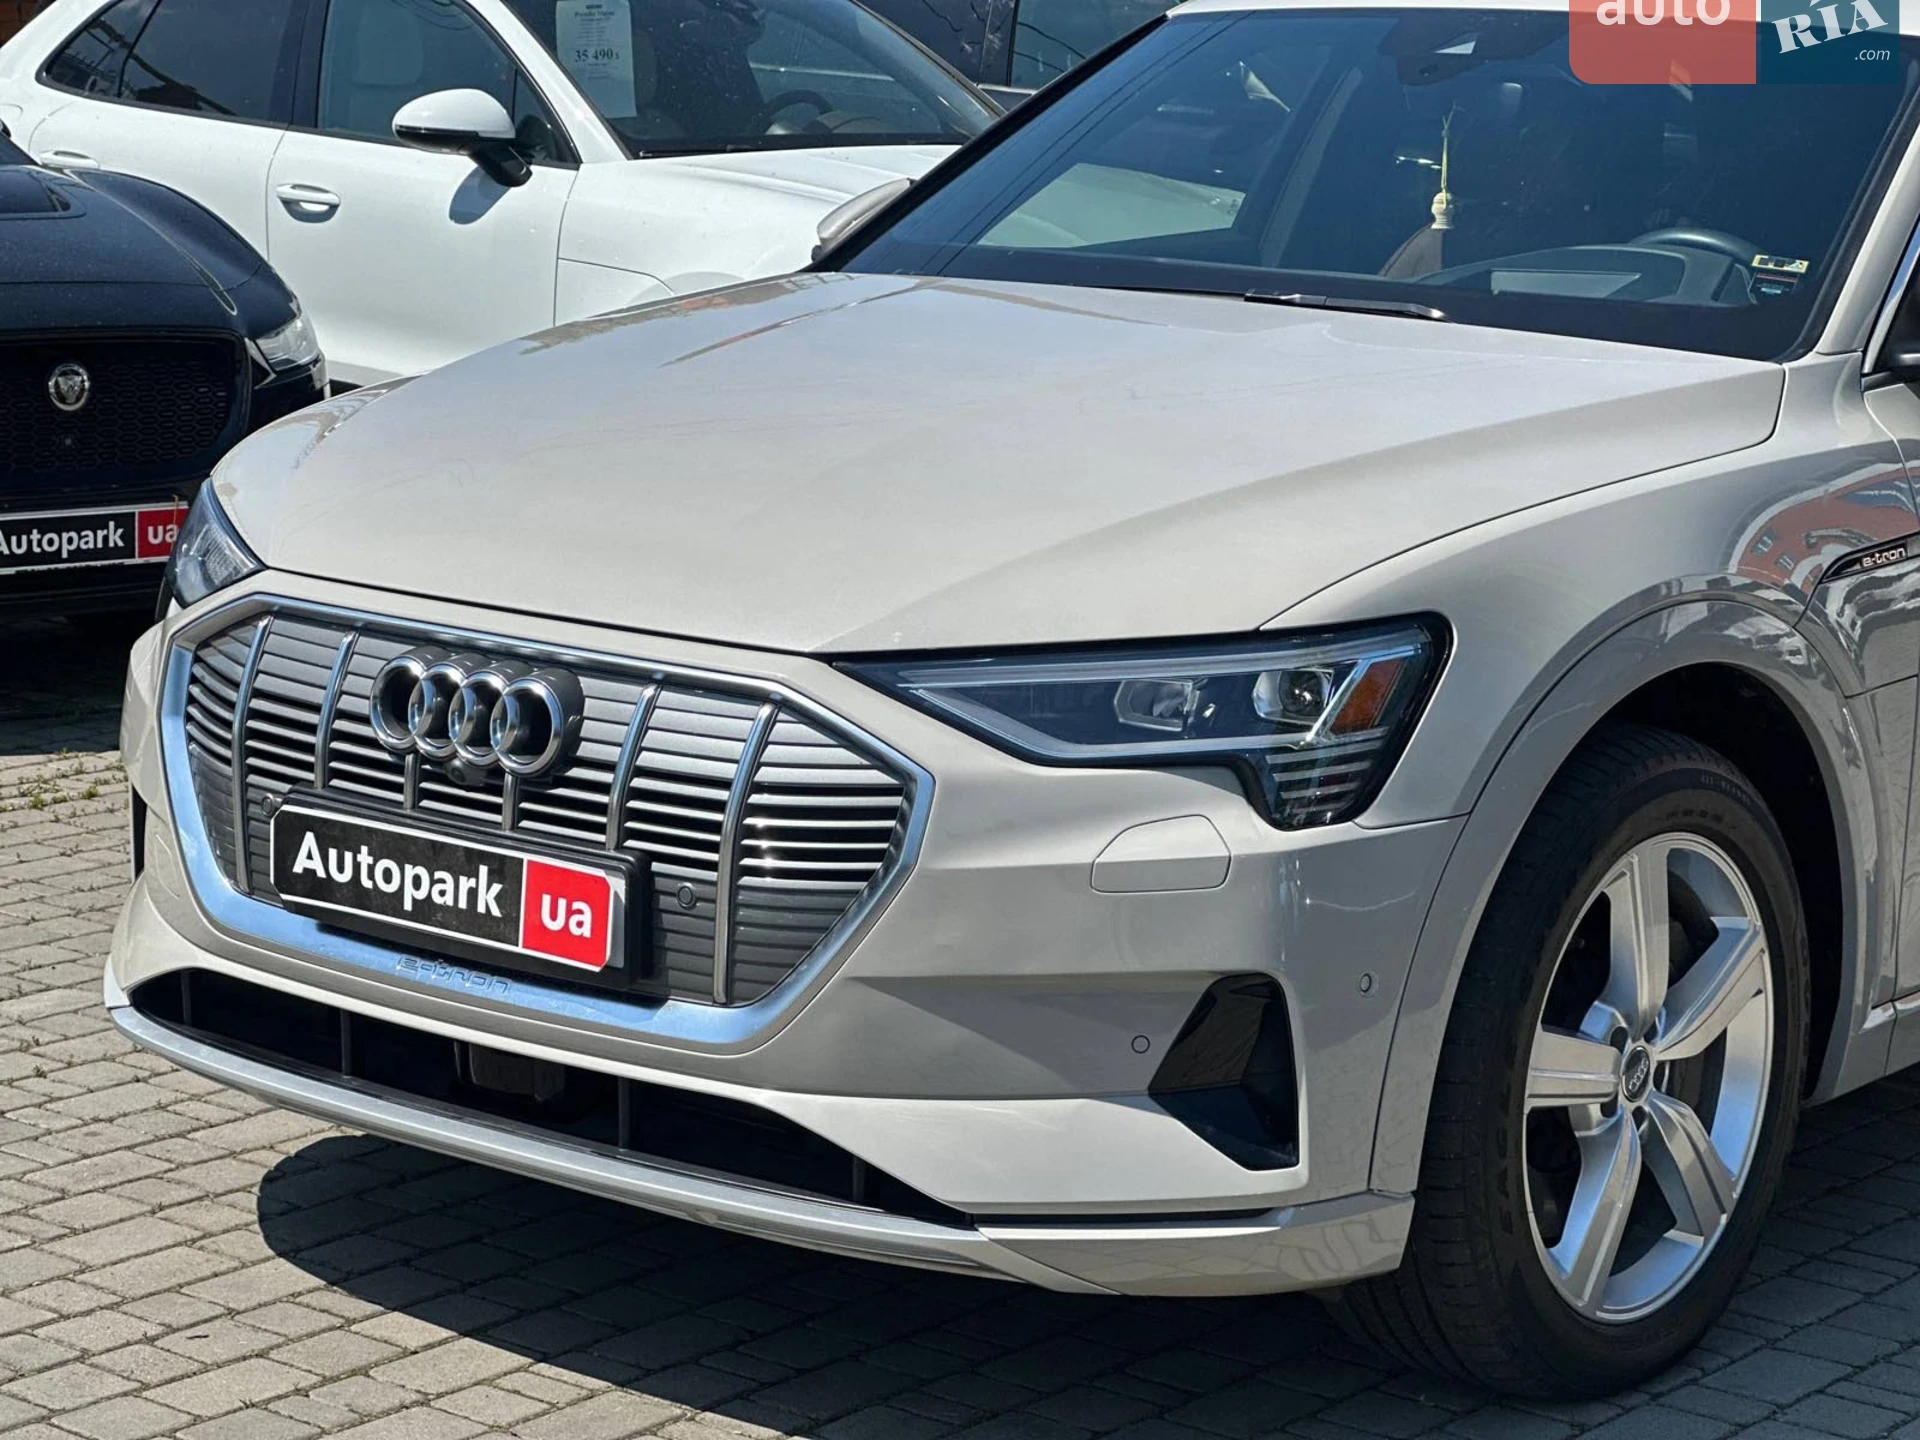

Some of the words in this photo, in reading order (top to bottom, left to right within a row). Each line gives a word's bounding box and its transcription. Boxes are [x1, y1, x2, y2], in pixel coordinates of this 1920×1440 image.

[574, 49, 589, 62] 35
[591, 48, 614, 61] 490
[147, 523, 181, 545] ua
[1863, 548, 1906, 567] e-tron
[292, 831, 504, 918] Autopark
[540, 893, 593, 939] ua
